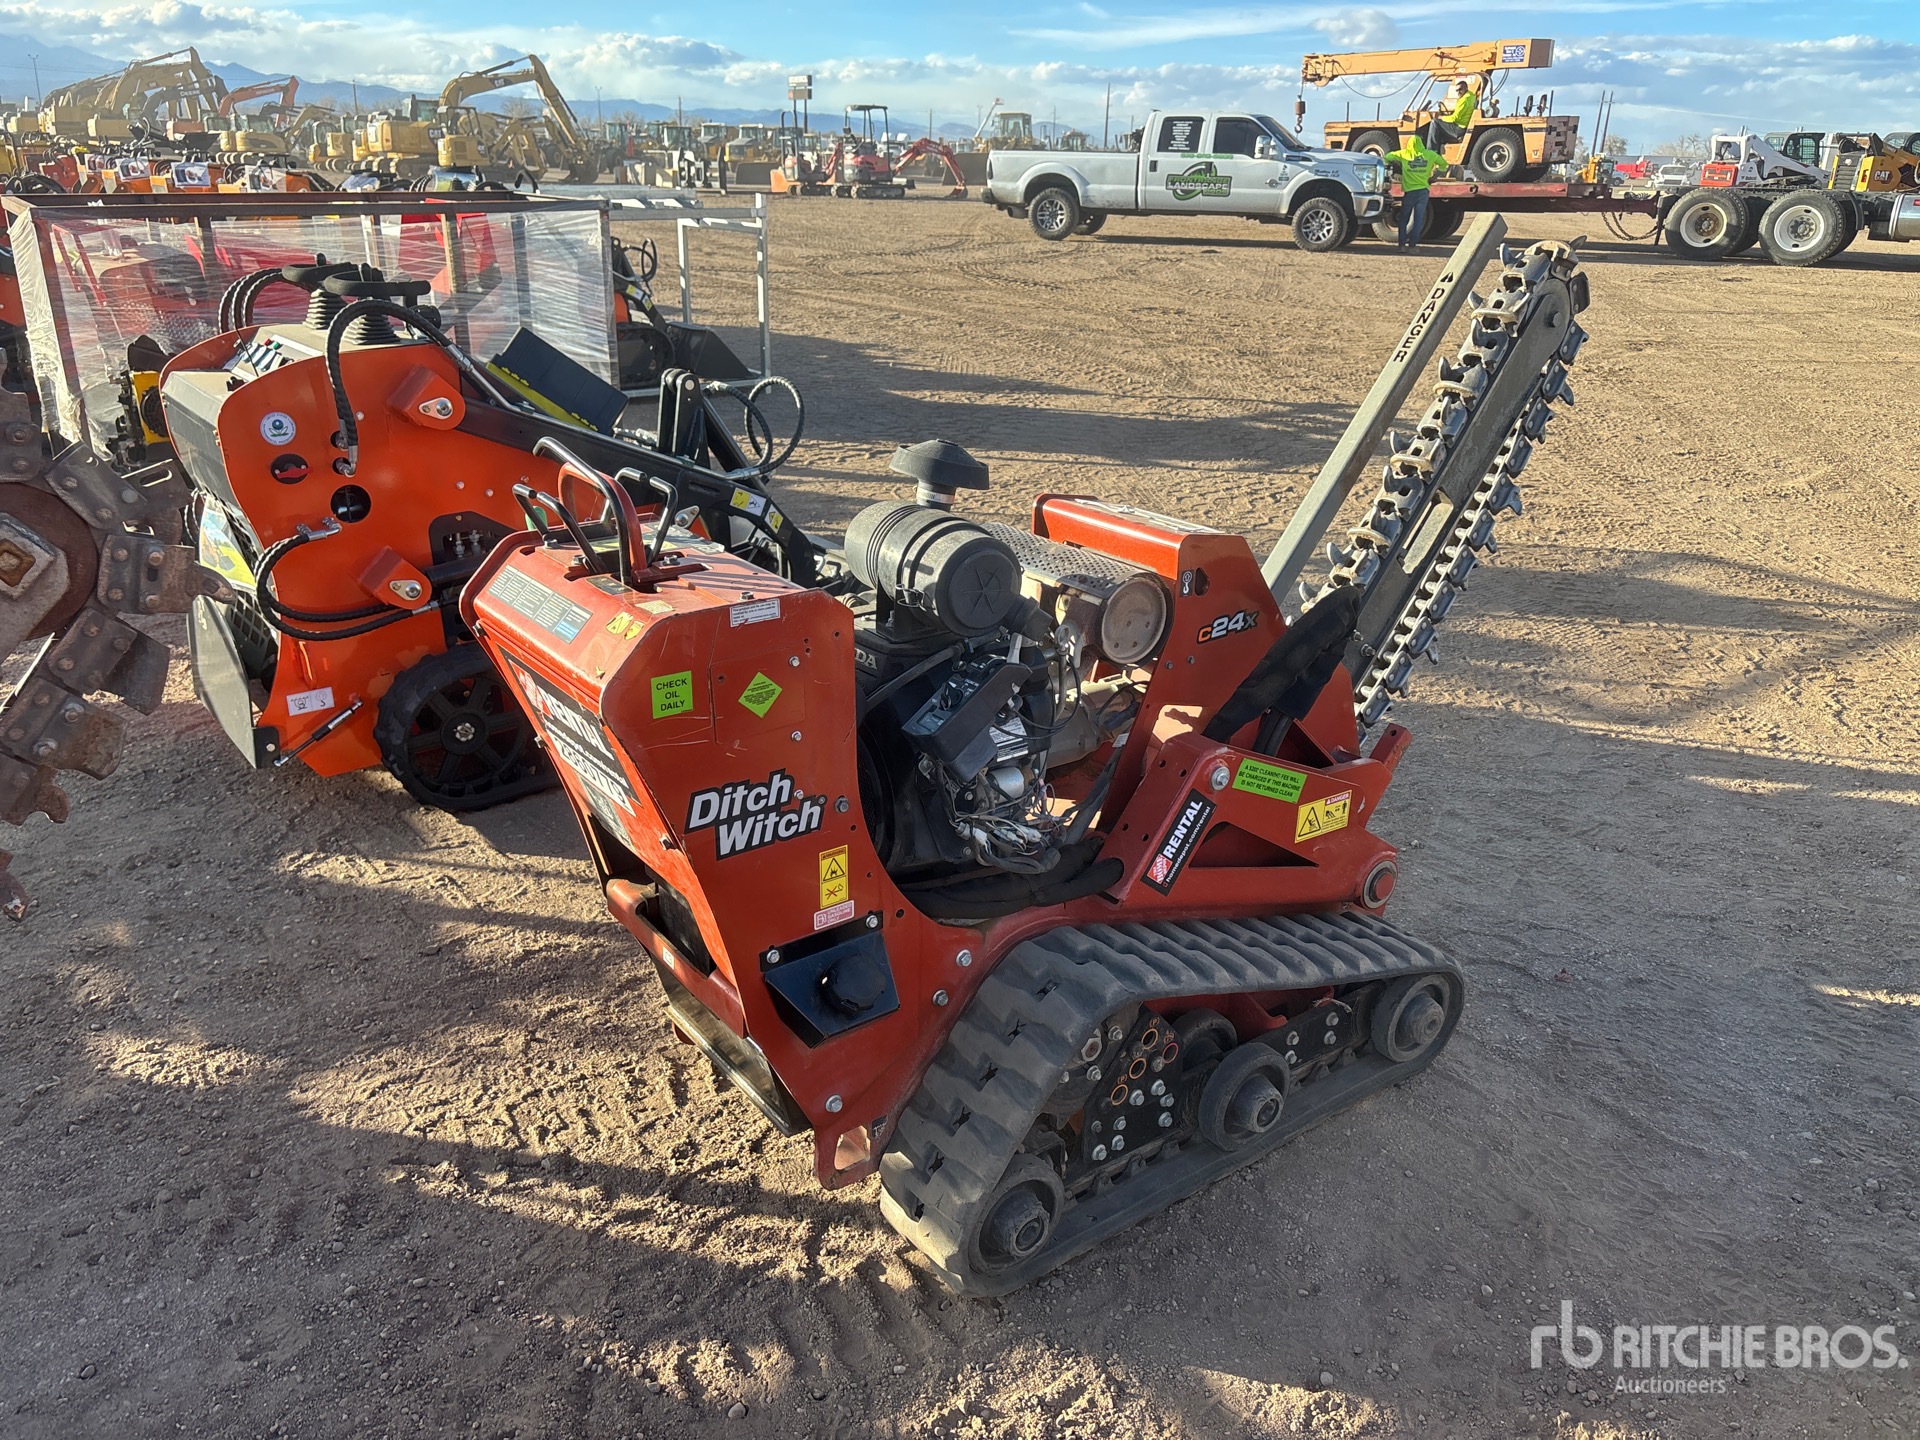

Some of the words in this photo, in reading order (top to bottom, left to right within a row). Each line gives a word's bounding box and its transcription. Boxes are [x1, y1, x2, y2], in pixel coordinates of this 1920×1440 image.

[1874, 170, 1890, 181] CAT
[1167, 182, 1229, 190] LANDSCAPE
[1393, 288, 1445, 363] DANGER
[656, 678, 688, 690] CHECK
[665, 691, 680, 700] OIL
[660, 700, 686, 711] DAILY
[536, 685, 615, 760] RENTAL
[1245, 773, 1268, 783] CHARGED
[1255, 784, 1279, 794] RETURNED
[689, 774, 791, 829] Ditch
[1331, 793, 1350, 803] DANGER
[719, 803, 821, 856] Witch
[1162, 800, 1203, 859] RENTAL
[1165, 806, 1211, 883] homedepot.com/rental
[828, 903, 852, 914] UNLEADED
[828, 908, 851, 919] GASOLINE
